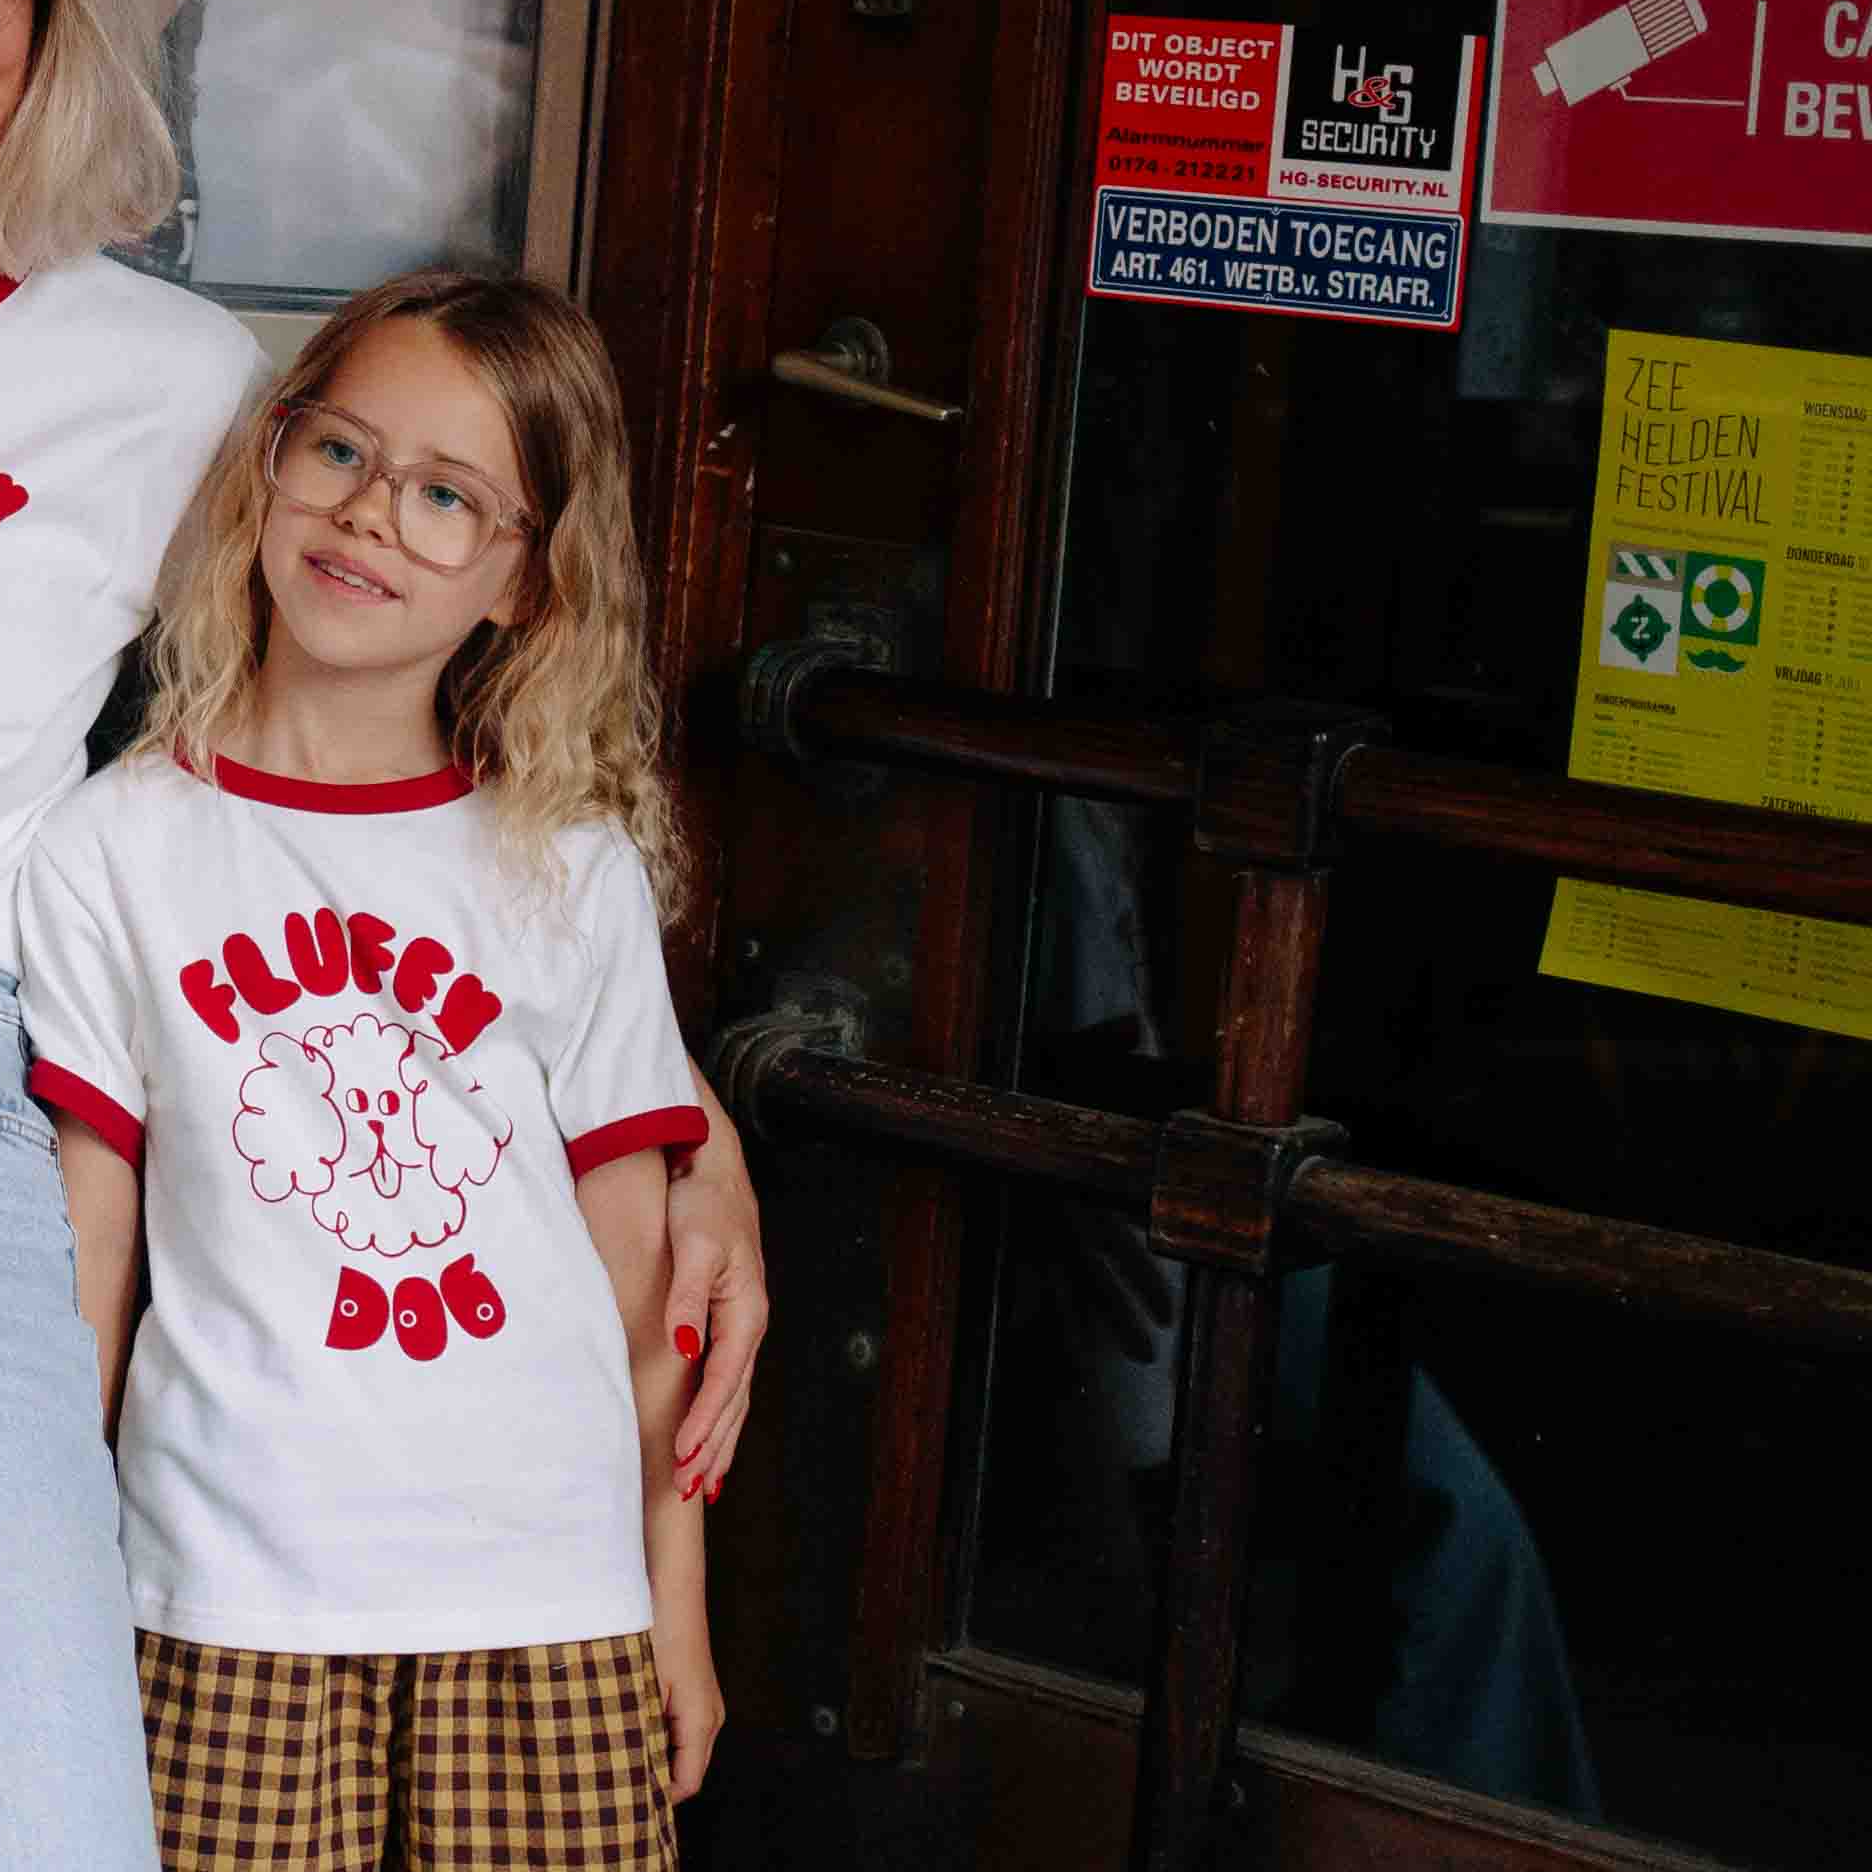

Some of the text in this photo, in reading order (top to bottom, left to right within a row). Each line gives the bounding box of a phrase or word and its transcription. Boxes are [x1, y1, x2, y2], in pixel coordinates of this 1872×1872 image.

[1111, 30, 1276, 61] DIT OBJECT
[1137, 56, 1243, 85] WORDT
[1114, 81, 1261, 112] BEVEILIGD
[1301, 119, 1436, 160] SECURITY
[1108, 154, 1159, 175] 0174
[1279, 169, 1450, 198] HG-SECURITY.NL
[1106, 203, 1448, 270] VERBODEN TOEGANG
[1110, 249, 1163, 282] ART.
[1168, 256, 1216, 287] 461.
[1327, 270, 1436, 308] STRAFR.
[1624, 356, 1693, 413] ZEE
[1621, 411, 1761, 465] HELDEN
[1615, 463, 1773, 527] FESTIVAL
[1784, 544, 1855, 569] DONDERDAG
[1775, 664, 1823, 686] VRIJDAG
[179, 907, 503, 1056] FLUFFY
[325, 1253, 507, 1362] DOG
